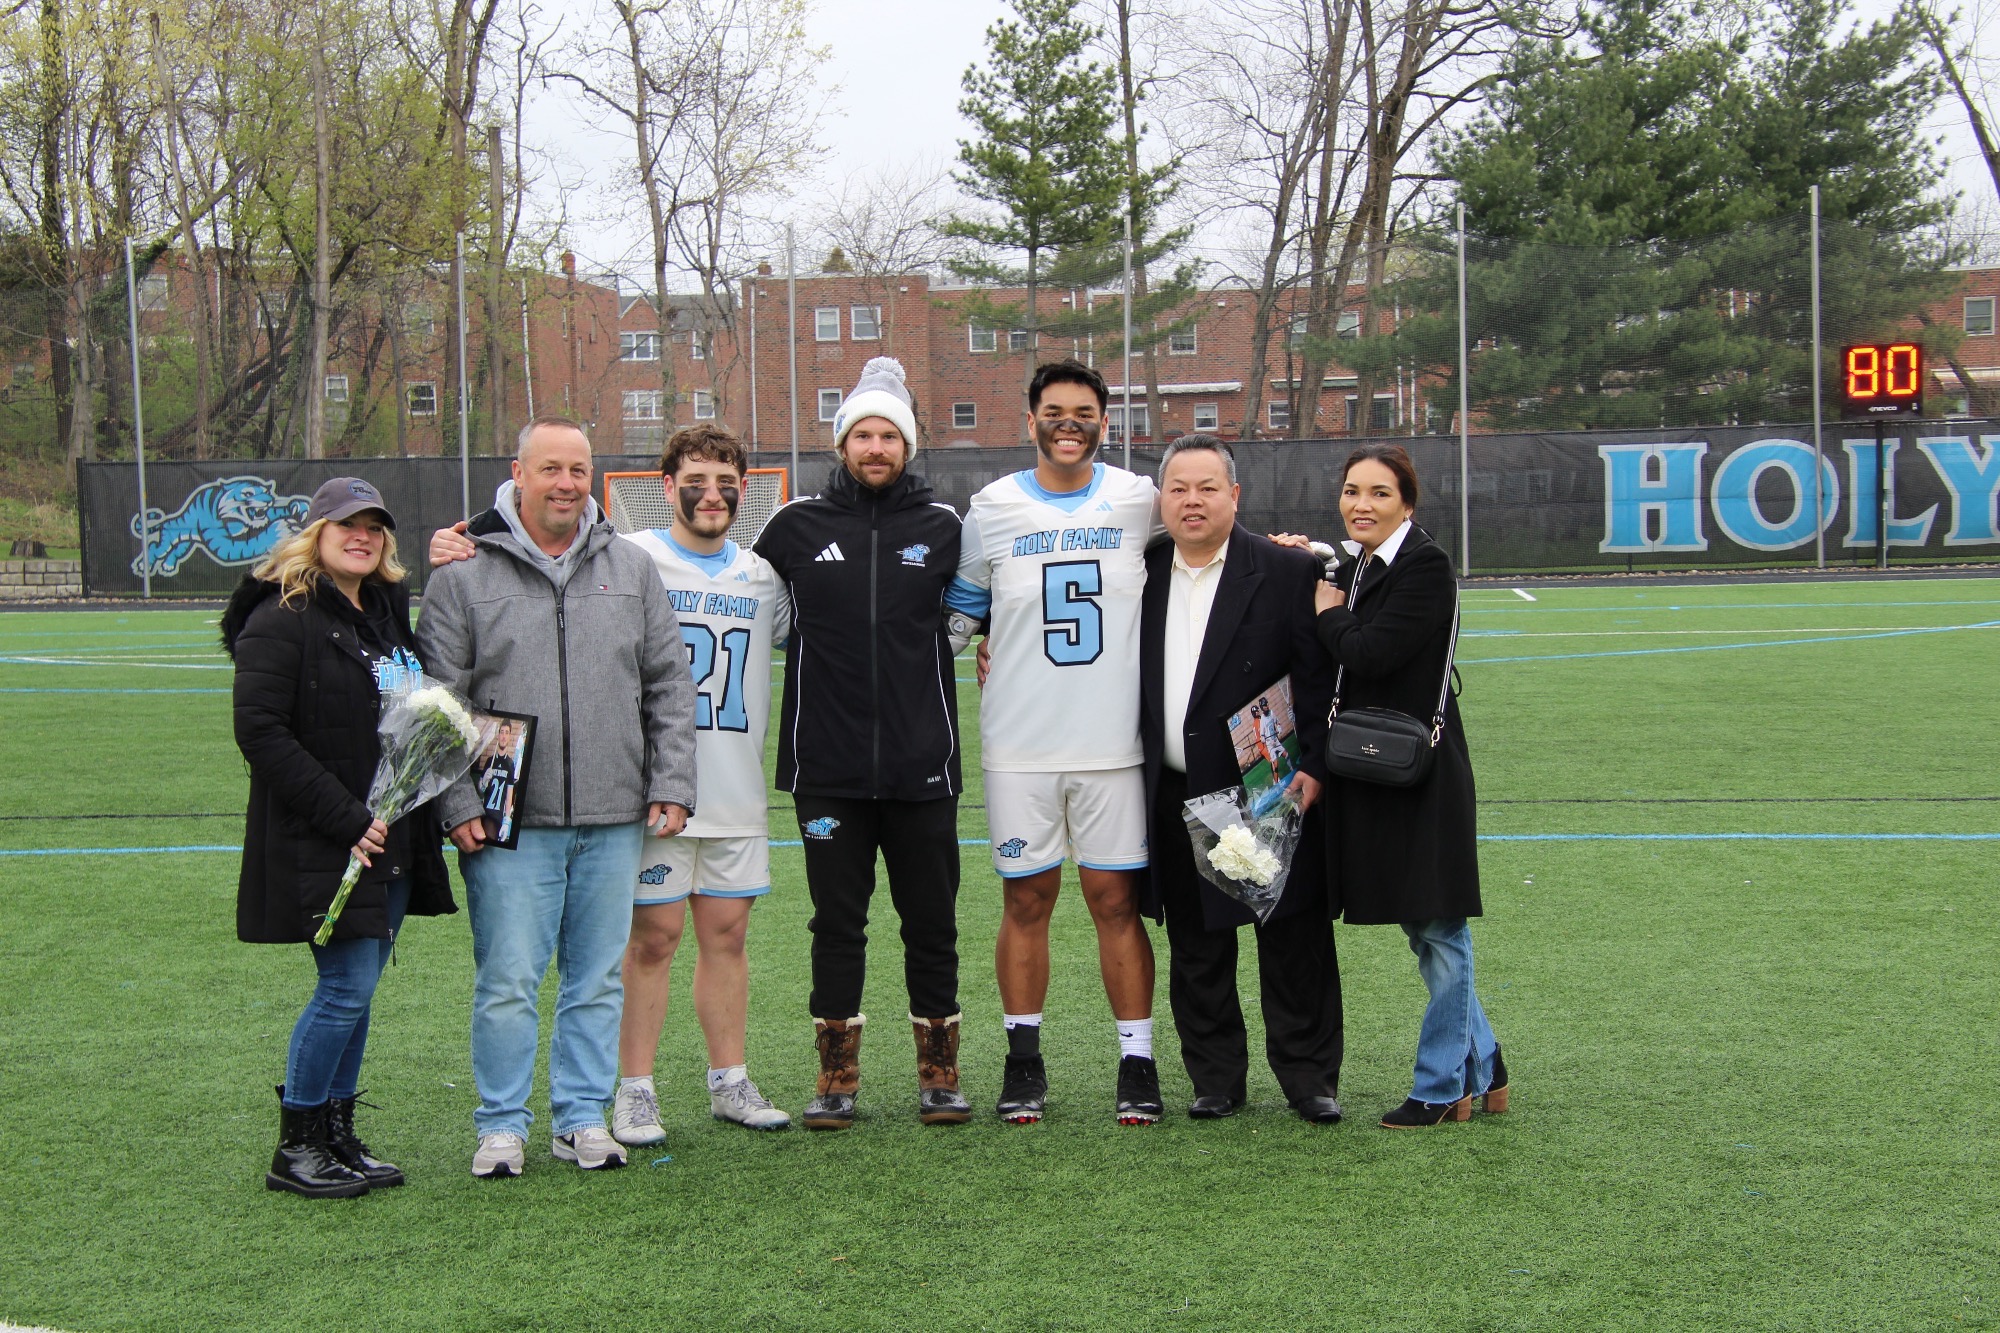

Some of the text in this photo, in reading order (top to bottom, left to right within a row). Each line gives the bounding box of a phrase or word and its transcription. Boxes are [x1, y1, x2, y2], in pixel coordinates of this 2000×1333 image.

[1848, 345, 1917, 397] 80
[1598, 435, 2000, 553] HOLY
[1012, 527, 1123, 557] HOLY FAMILY
[666, 590, 759, 620] OLY FAMILY
[1042, 559, 1103, 667] 5
[486, 778, 505, 810] 21
